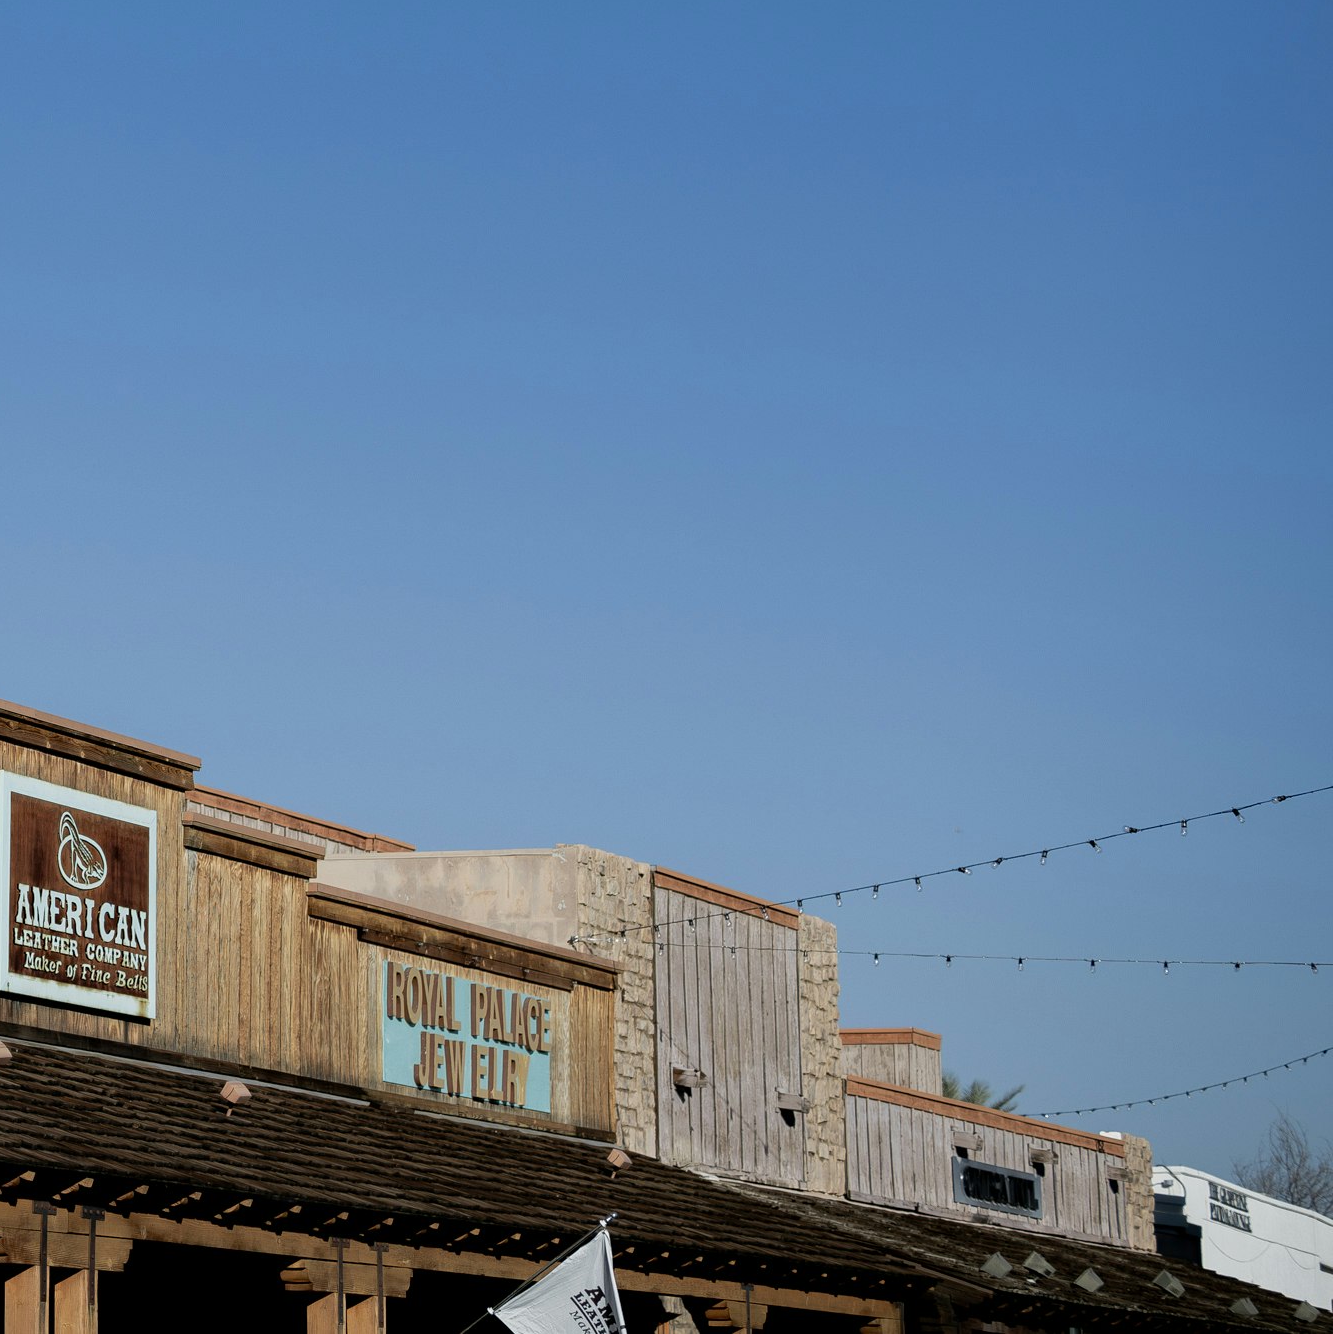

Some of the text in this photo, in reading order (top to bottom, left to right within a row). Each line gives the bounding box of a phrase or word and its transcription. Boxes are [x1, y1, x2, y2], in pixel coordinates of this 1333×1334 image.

[13, 927, 147, 971] LEATHER COMPANY
[15, 883, 147, 951] AMERICAN
[24, 952, 148, 991] Maker of Fine Belts
[387, 961, 552, 1053] ROYAL PALACE
[414, 1031, 530, 1107] JEWELRY
